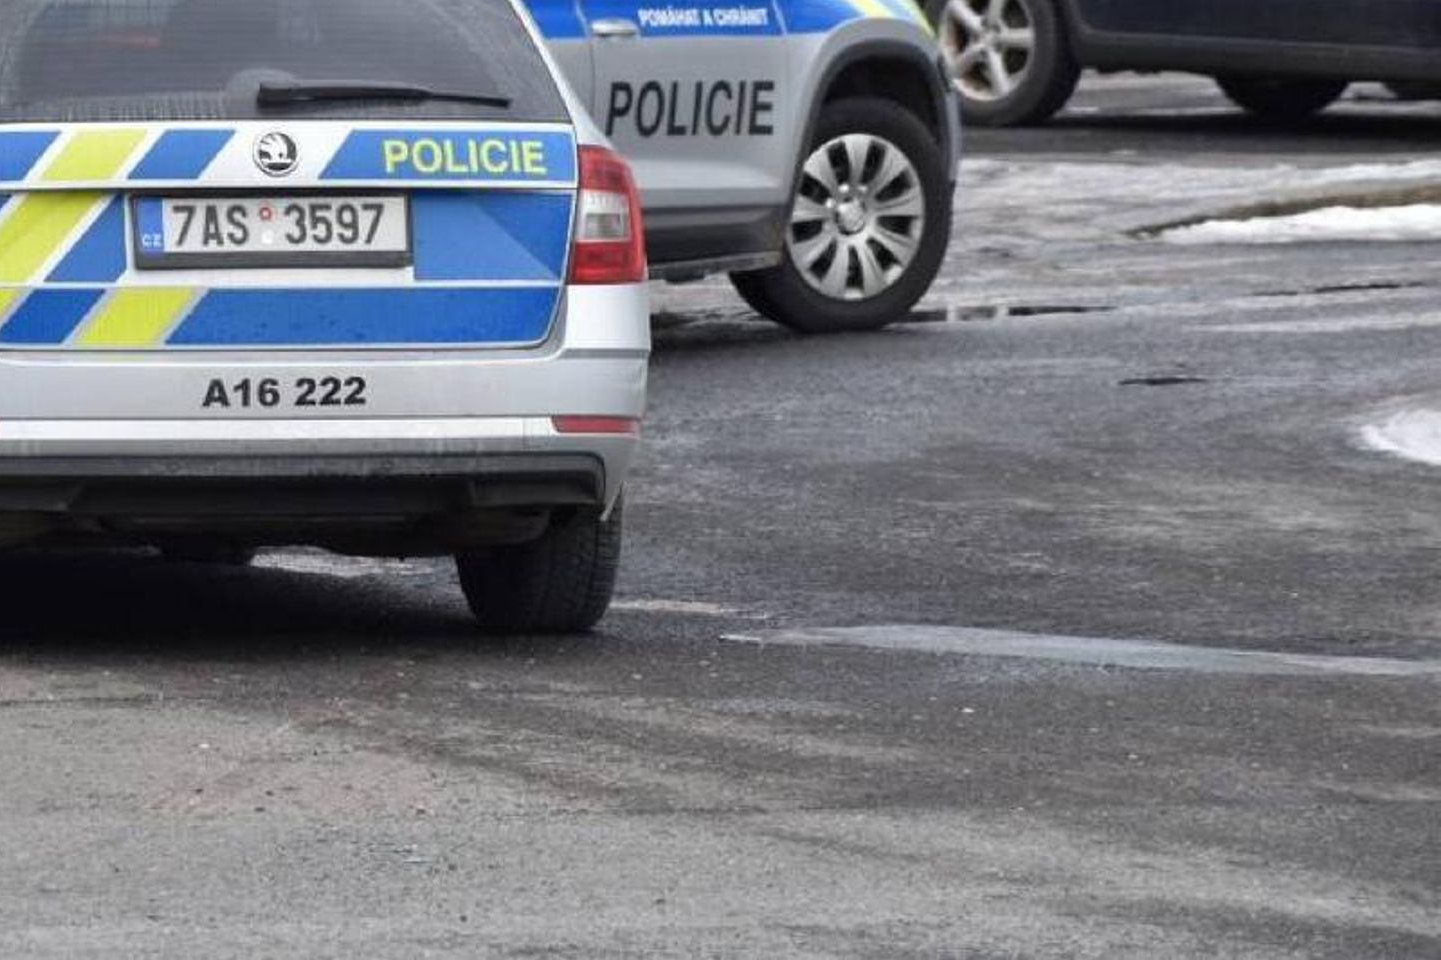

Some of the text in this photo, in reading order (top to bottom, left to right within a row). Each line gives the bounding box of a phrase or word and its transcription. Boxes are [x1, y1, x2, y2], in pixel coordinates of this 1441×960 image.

[605, 80, 775, 137] POLICIE
[383, 138, 548, 174] POLICIE
[172, 202, 386, 248] 7AS 3597
[202, 376, 367, 408] A16 222
